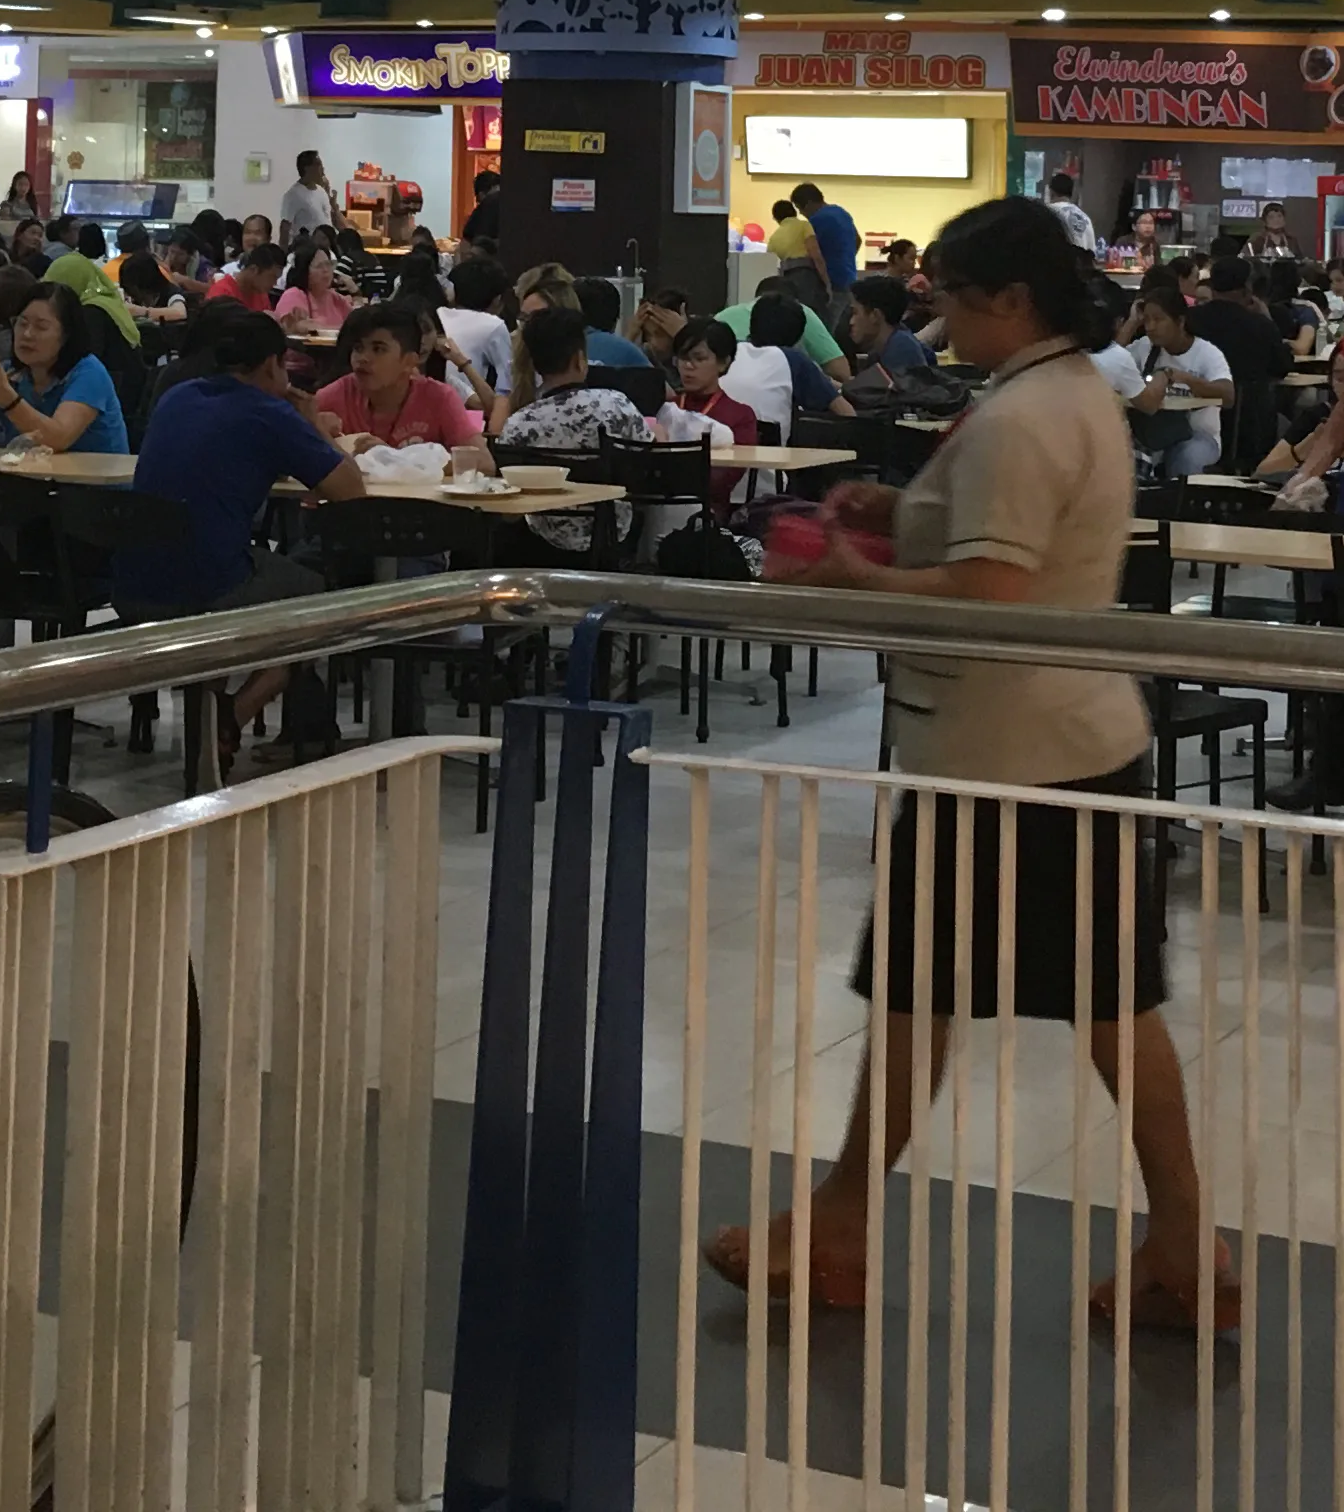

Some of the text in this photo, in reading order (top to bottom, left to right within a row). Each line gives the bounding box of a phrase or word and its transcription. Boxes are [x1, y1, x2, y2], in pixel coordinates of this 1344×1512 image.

[822, 29, 912, 54] MANG
[434, 40, 511, 89] TOPP
[754, 53, 986, 89] JUAN SILOG
[1053, 45, 1249, 86] Elvindrew's
[1037, 84, 1269, 129] KAMBINGAN
